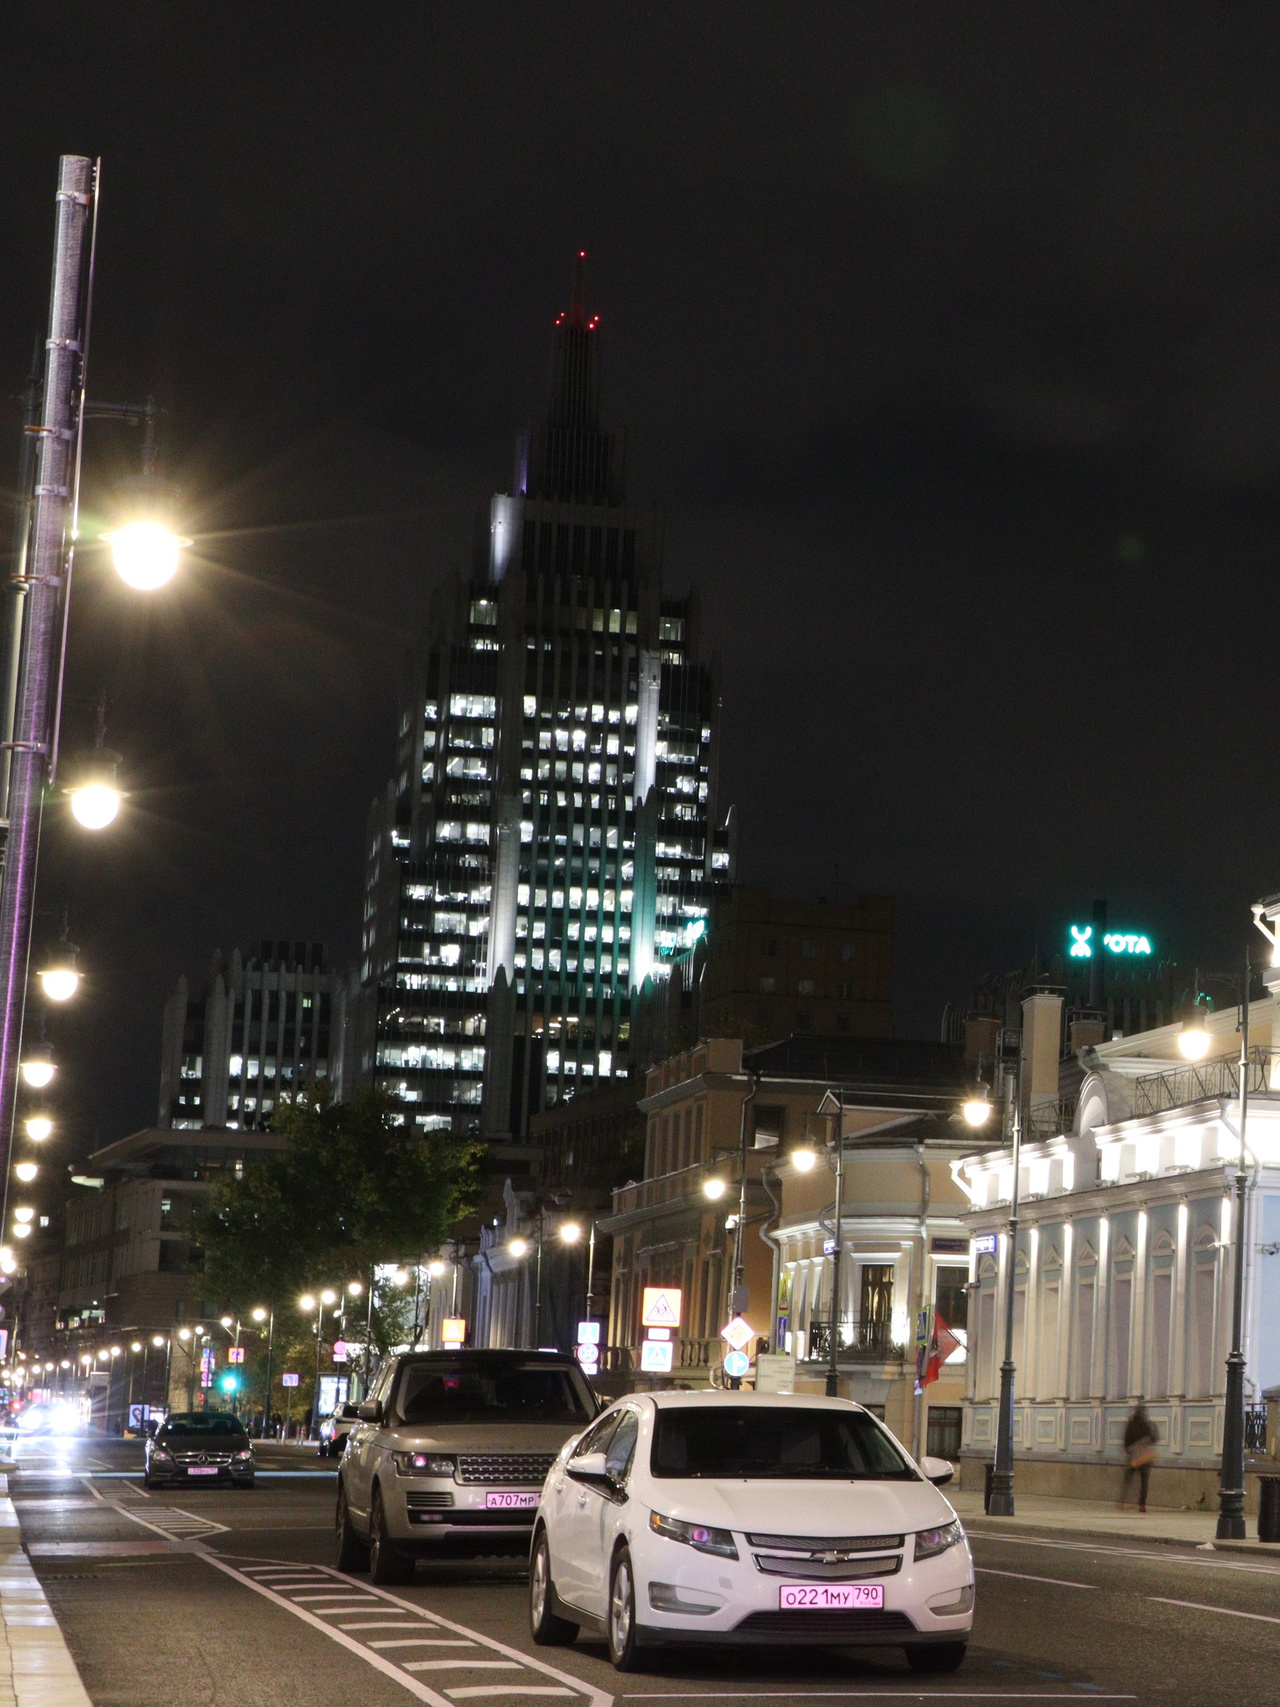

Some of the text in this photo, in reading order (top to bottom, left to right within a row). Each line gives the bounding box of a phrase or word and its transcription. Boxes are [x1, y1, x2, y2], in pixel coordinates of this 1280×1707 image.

[490, 1494, 534, 1506] А707МР
[786, 1587, 878, 1605] О221МУ 790
